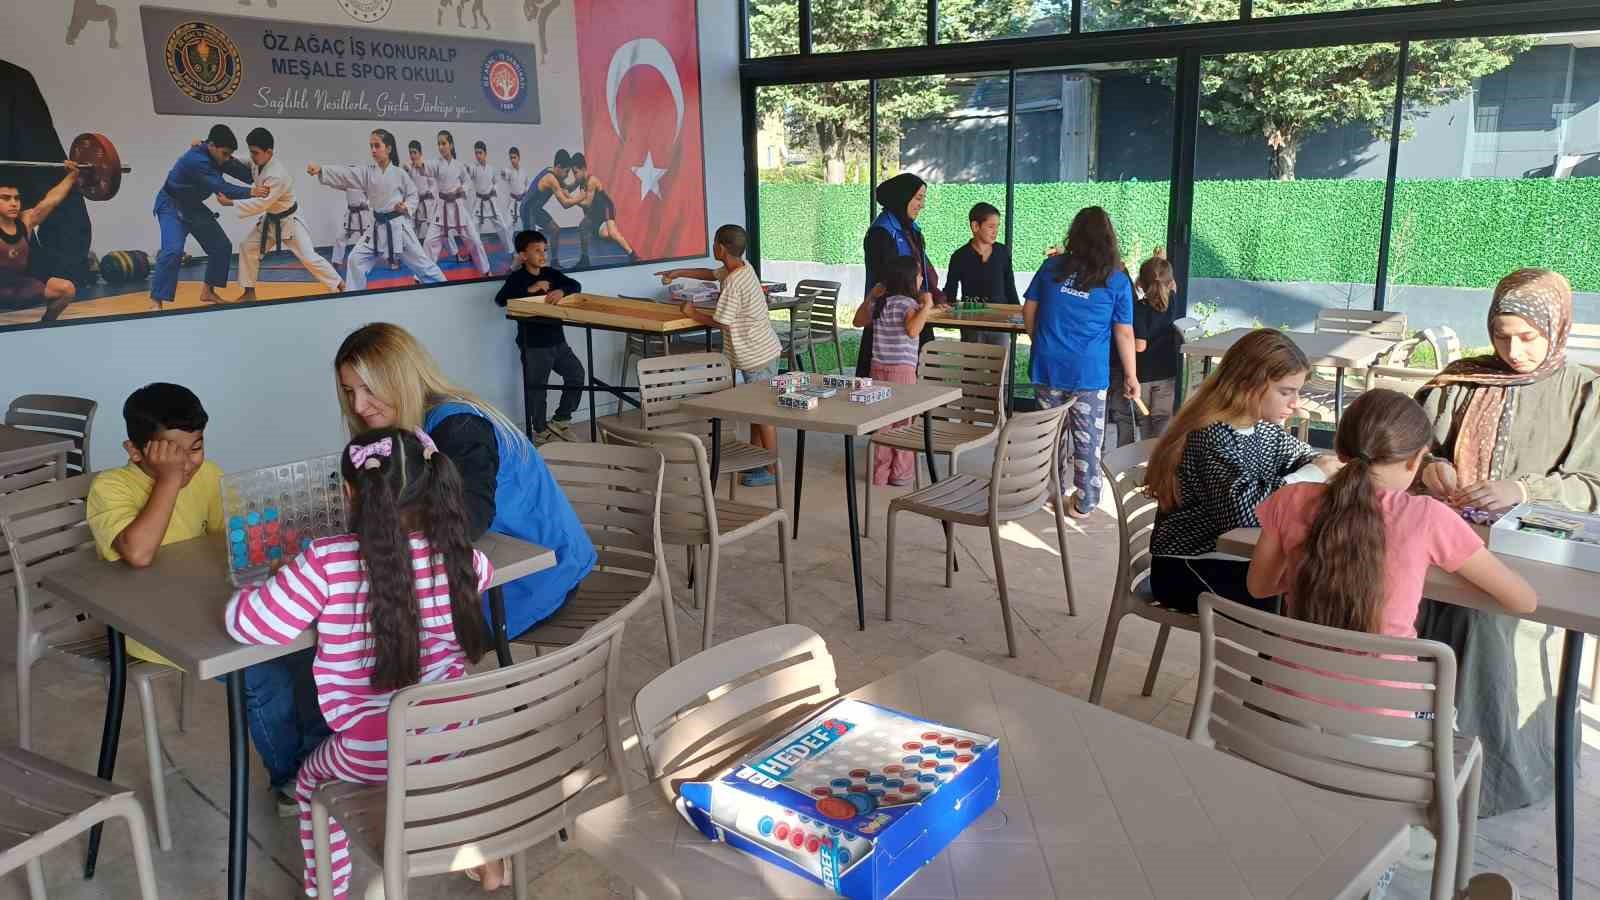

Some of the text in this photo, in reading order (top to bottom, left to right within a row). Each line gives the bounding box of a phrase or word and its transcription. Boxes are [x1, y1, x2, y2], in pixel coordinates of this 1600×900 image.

[263, 29, 457, 62] ÖZ AĞAÇ İŞ KONURALP
[271, 58, 454, 83] MEŞALE SPOR OKULU
[758, 728, 832, 776] HEDEF
